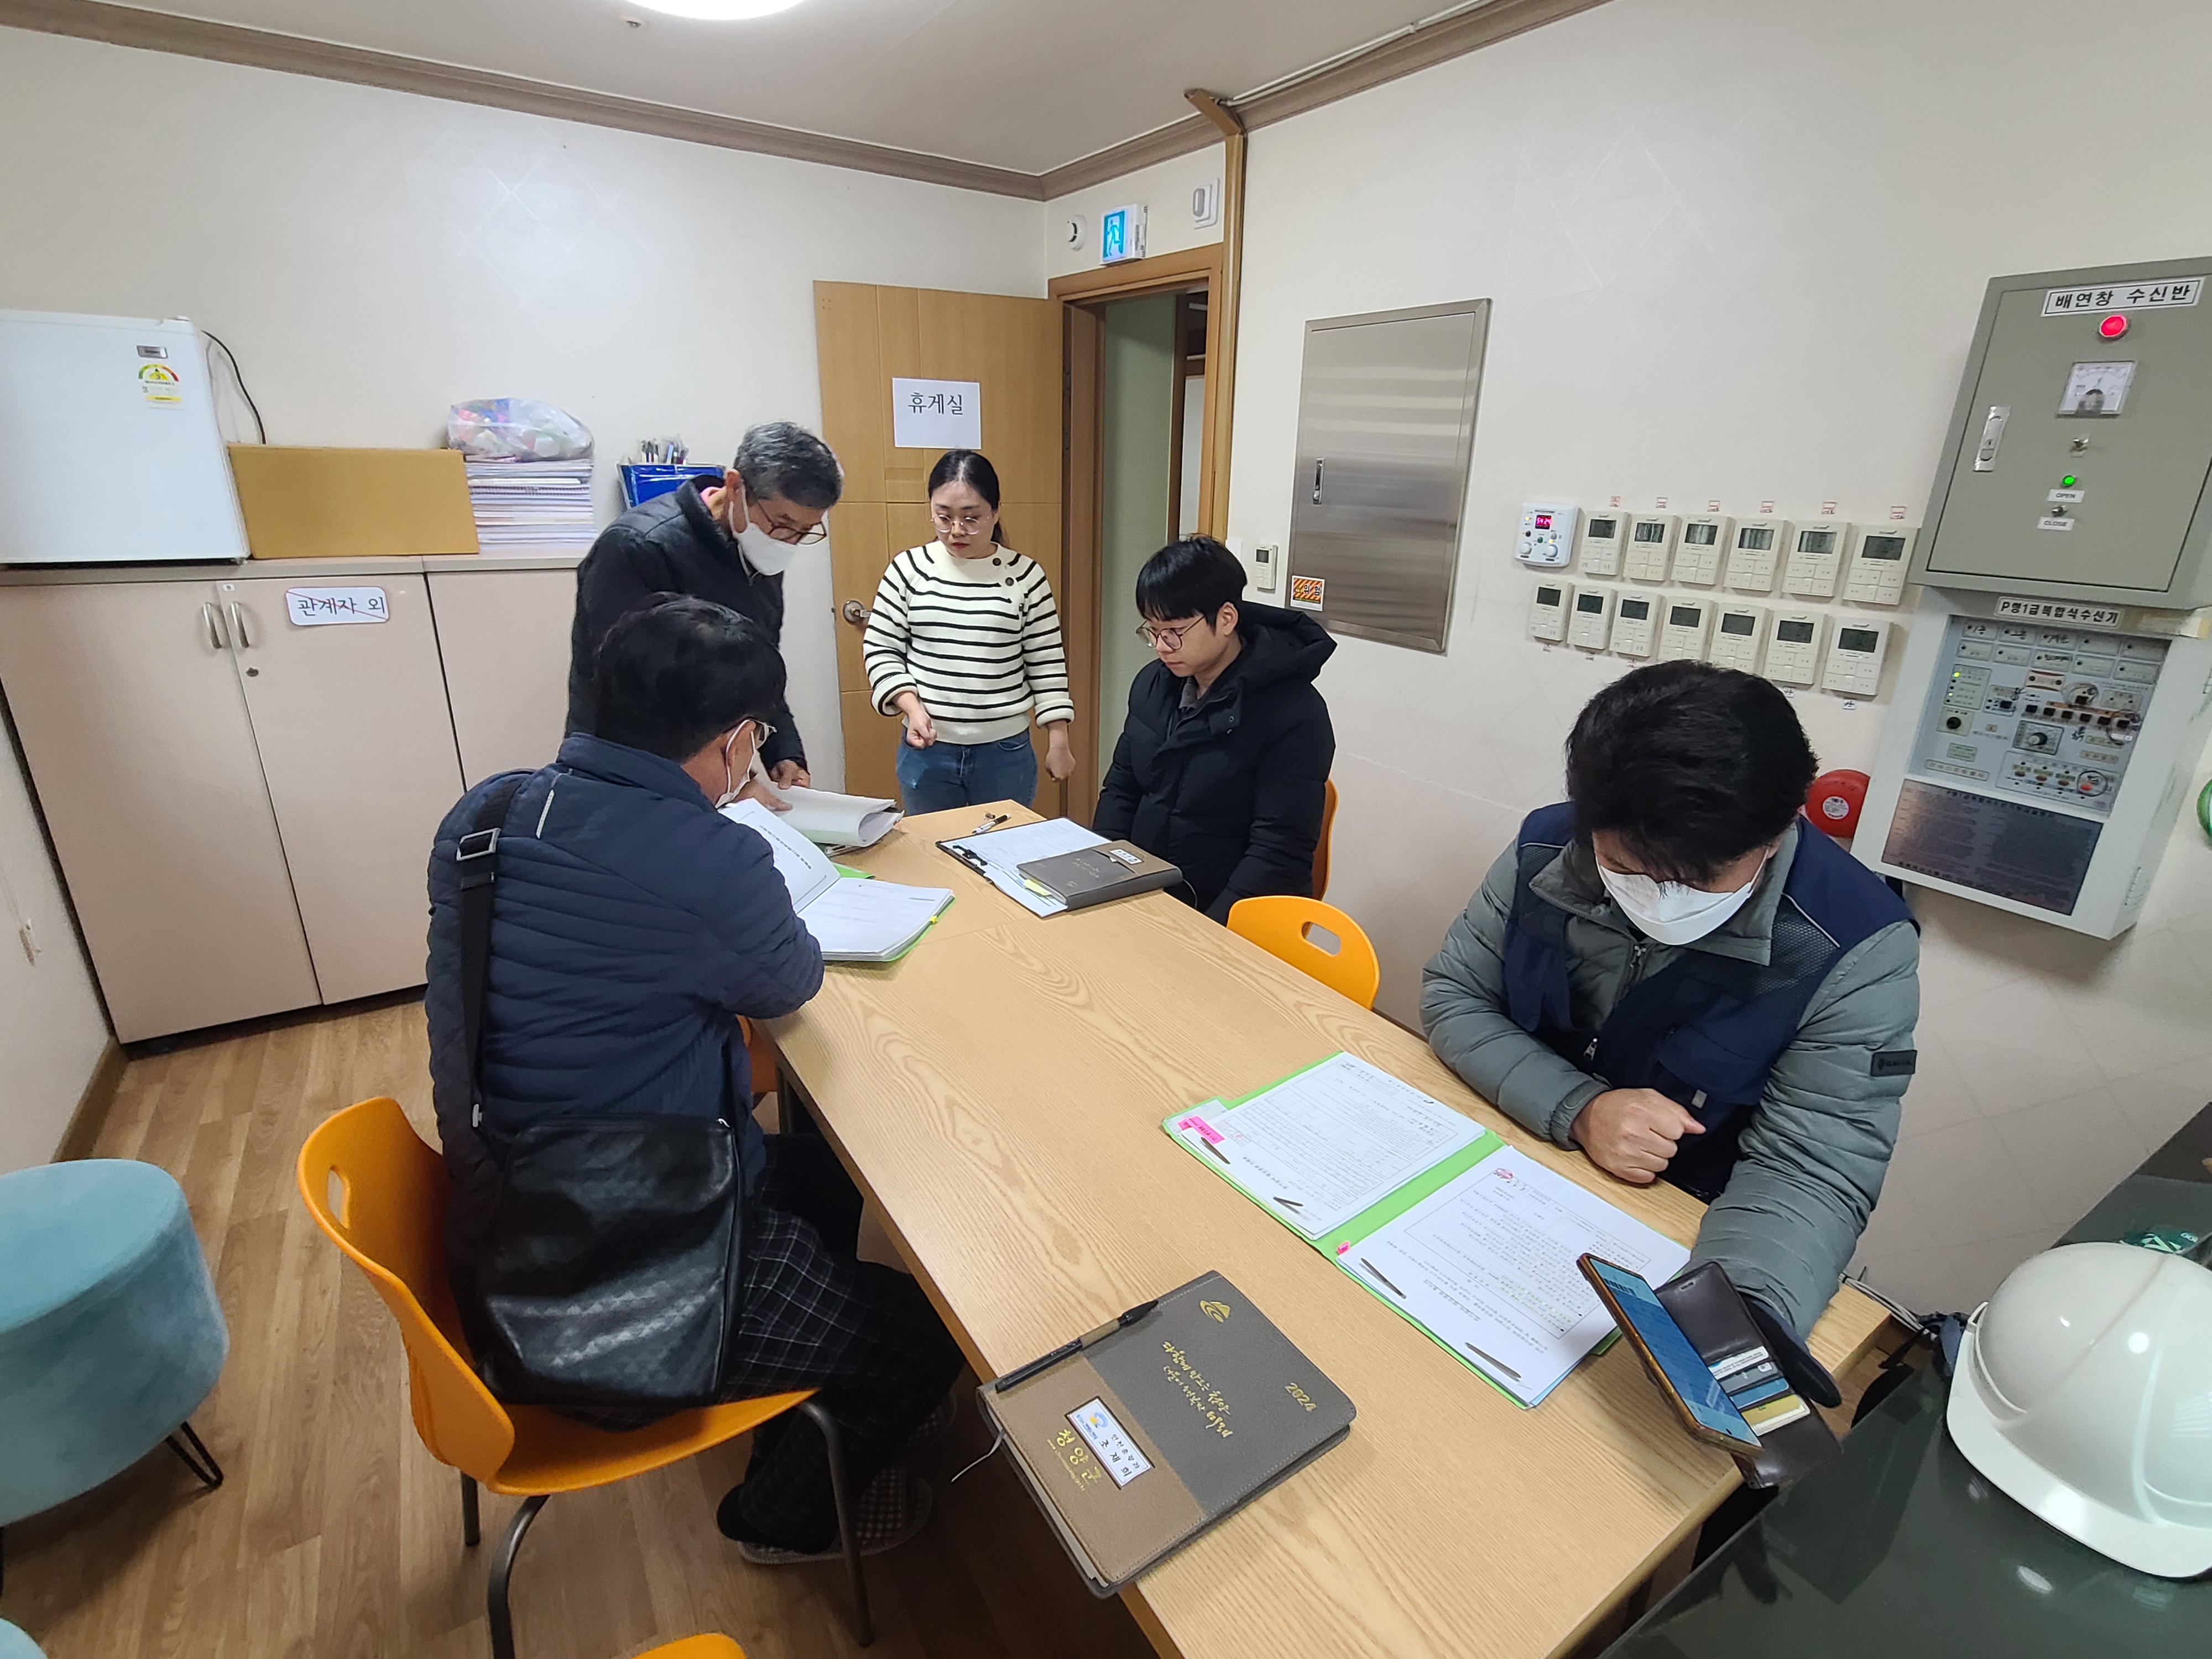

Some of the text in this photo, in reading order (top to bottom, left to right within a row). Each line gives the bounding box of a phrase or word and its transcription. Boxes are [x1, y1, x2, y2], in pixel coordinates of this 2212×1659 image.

[2055, 284, 2190, 309] 배연창 수신반
[908, 392, 963, 415] 휴게실
[298, 597, 385, 616] 관계자 외
[2000, 601, 2119, 624] P형1급복합식수신기
[1285, 1383, 1316, 1412] 2024
